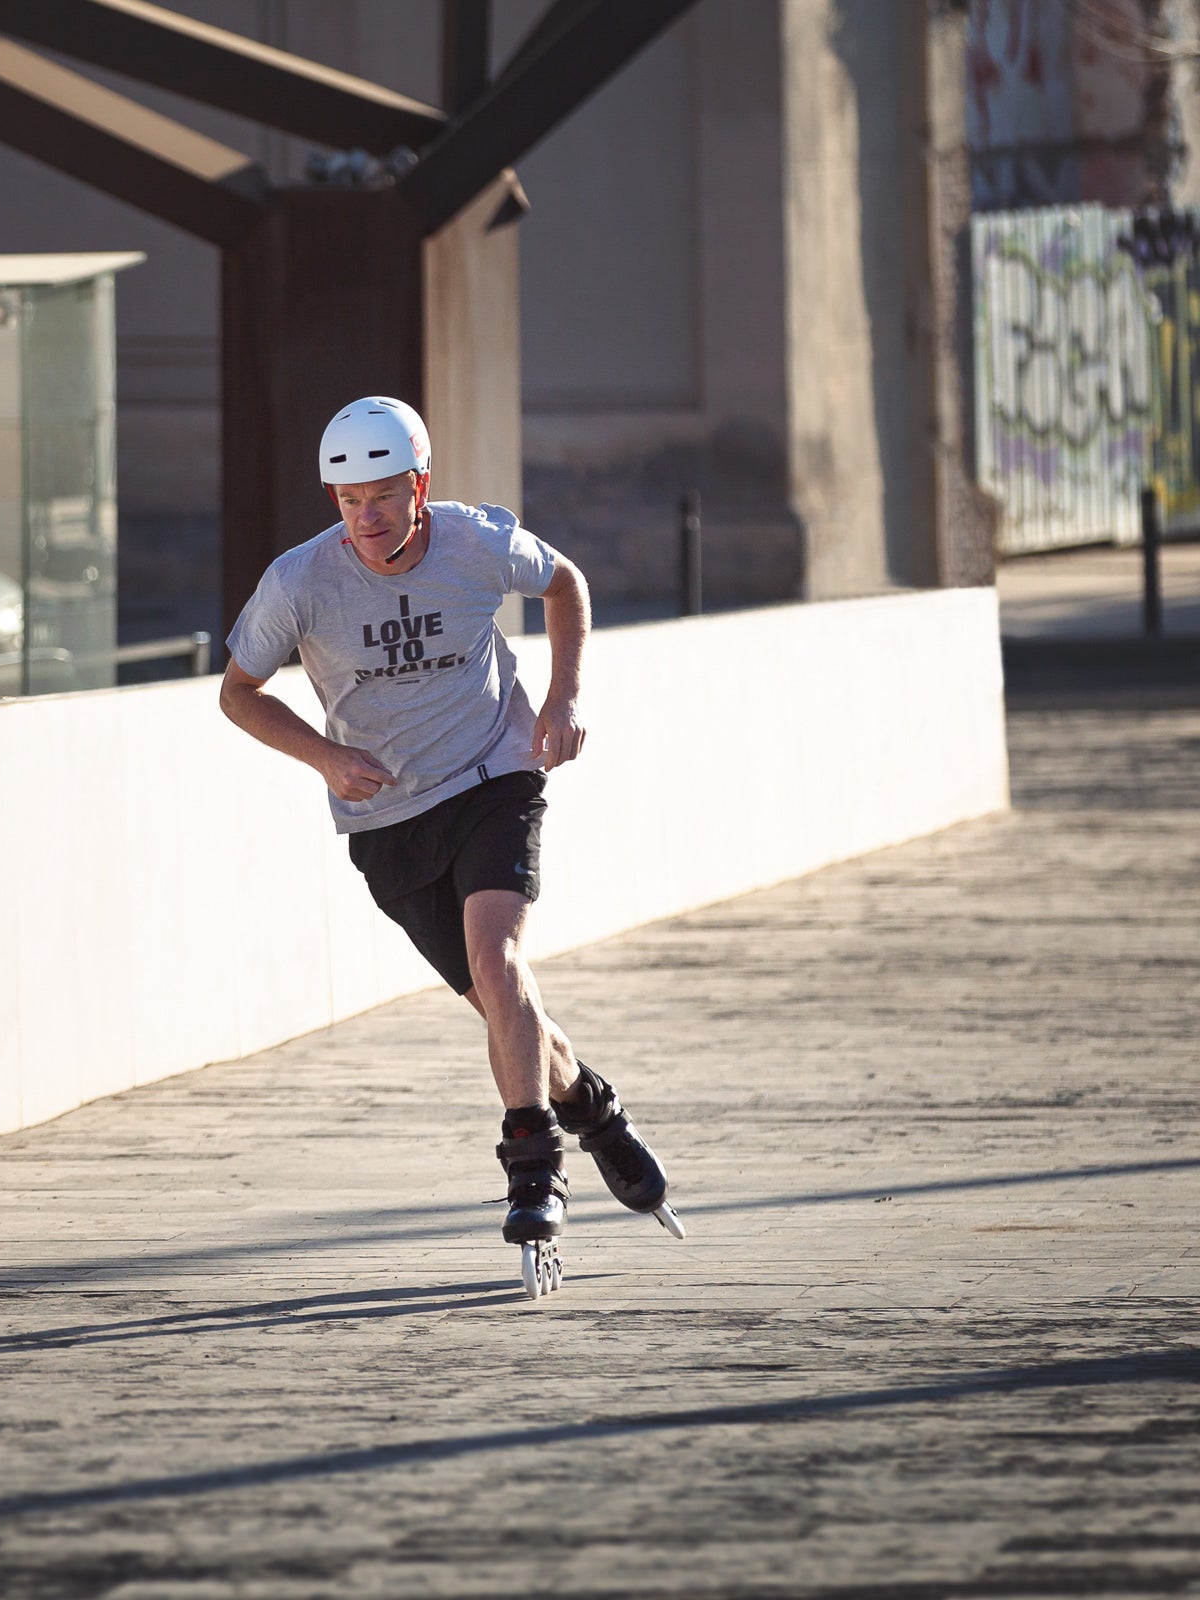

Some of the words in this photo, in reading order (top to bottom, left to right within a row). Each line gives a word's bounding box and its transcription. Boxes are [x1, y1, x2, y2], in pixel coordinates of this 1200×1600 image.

[399, 595, 409, 617] I
[363, 611, 443, 647] LOVE
[383, 639, 424, 665] TO
